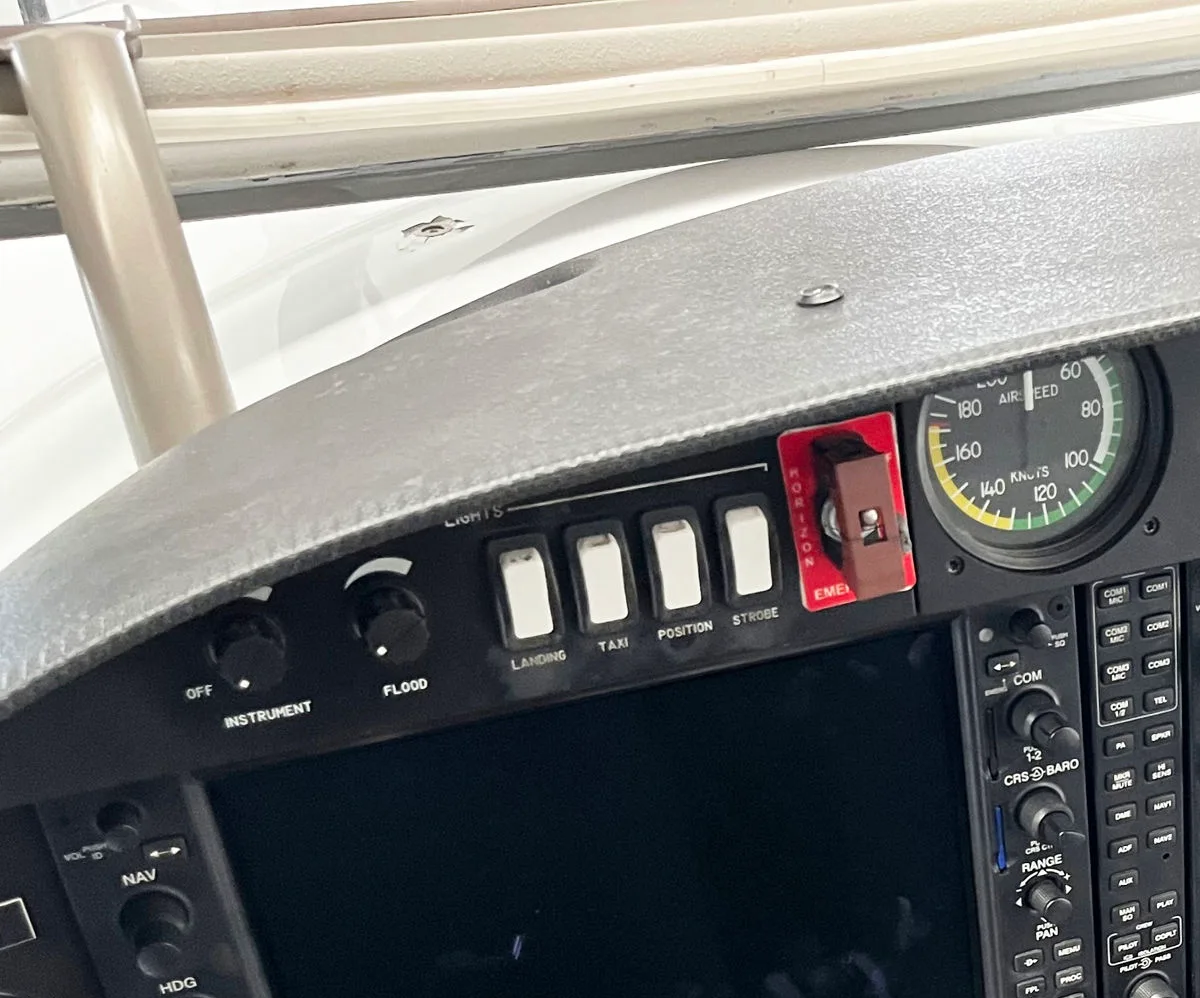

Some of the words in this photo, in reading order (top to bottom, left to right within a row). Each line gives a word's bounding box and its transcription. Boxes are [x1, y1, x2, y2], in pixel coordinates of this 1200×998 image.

[1060, 361, 1081, 380] 60
[957, 399, 982, 418] 180
[1081, 400, 1101, 418] 80
[956, 441, 981, 461] 160
[1064, 450, 1089, 468] 100
[980, 478, 1005, 498] 140
[1034, 483, 1057, 502] 120
[789, 468, 815, 566] HORIZON
[1104, 587, 1126, 598] COM1
[1146, 582, 1168, 593] COM1
[732, 607, 779, 626] STROBE
[658, 620, 713, 641] POSITION
[1105, 626, 1128, 637] COM2
[1147, 621, 1169, 631] COM2
[598, 637, 630, 653] TAXI
[511, 650, 567, 670] LANDING
[1148, 658, 1170, 669] COM3
[1013, 670, 1042, 686] COM
[186, 684, 213, 699] OFF
[383, 678, 428, 697] FLOOD
[223, 700, 312, 728] INSTRUMENT
[1026, 750, 1042, 762] 1-2
[1004, 771, 1029, 786] CRS
[1046, 759, 1079, 775] BARO
[1022, 854, 1062, 873] RANGE
[121, 869, 156, 886] NAV
[1036, 927, 1059, 940] PAN
[1154, 929, 1177, 941] COPLT
[1058, 945, 1080, 956] MENU
[1118, 940, 1138, 952] PILOT
[159, 977, 197, 994] HDG
[1060, 973, 1082, 984] PROC
